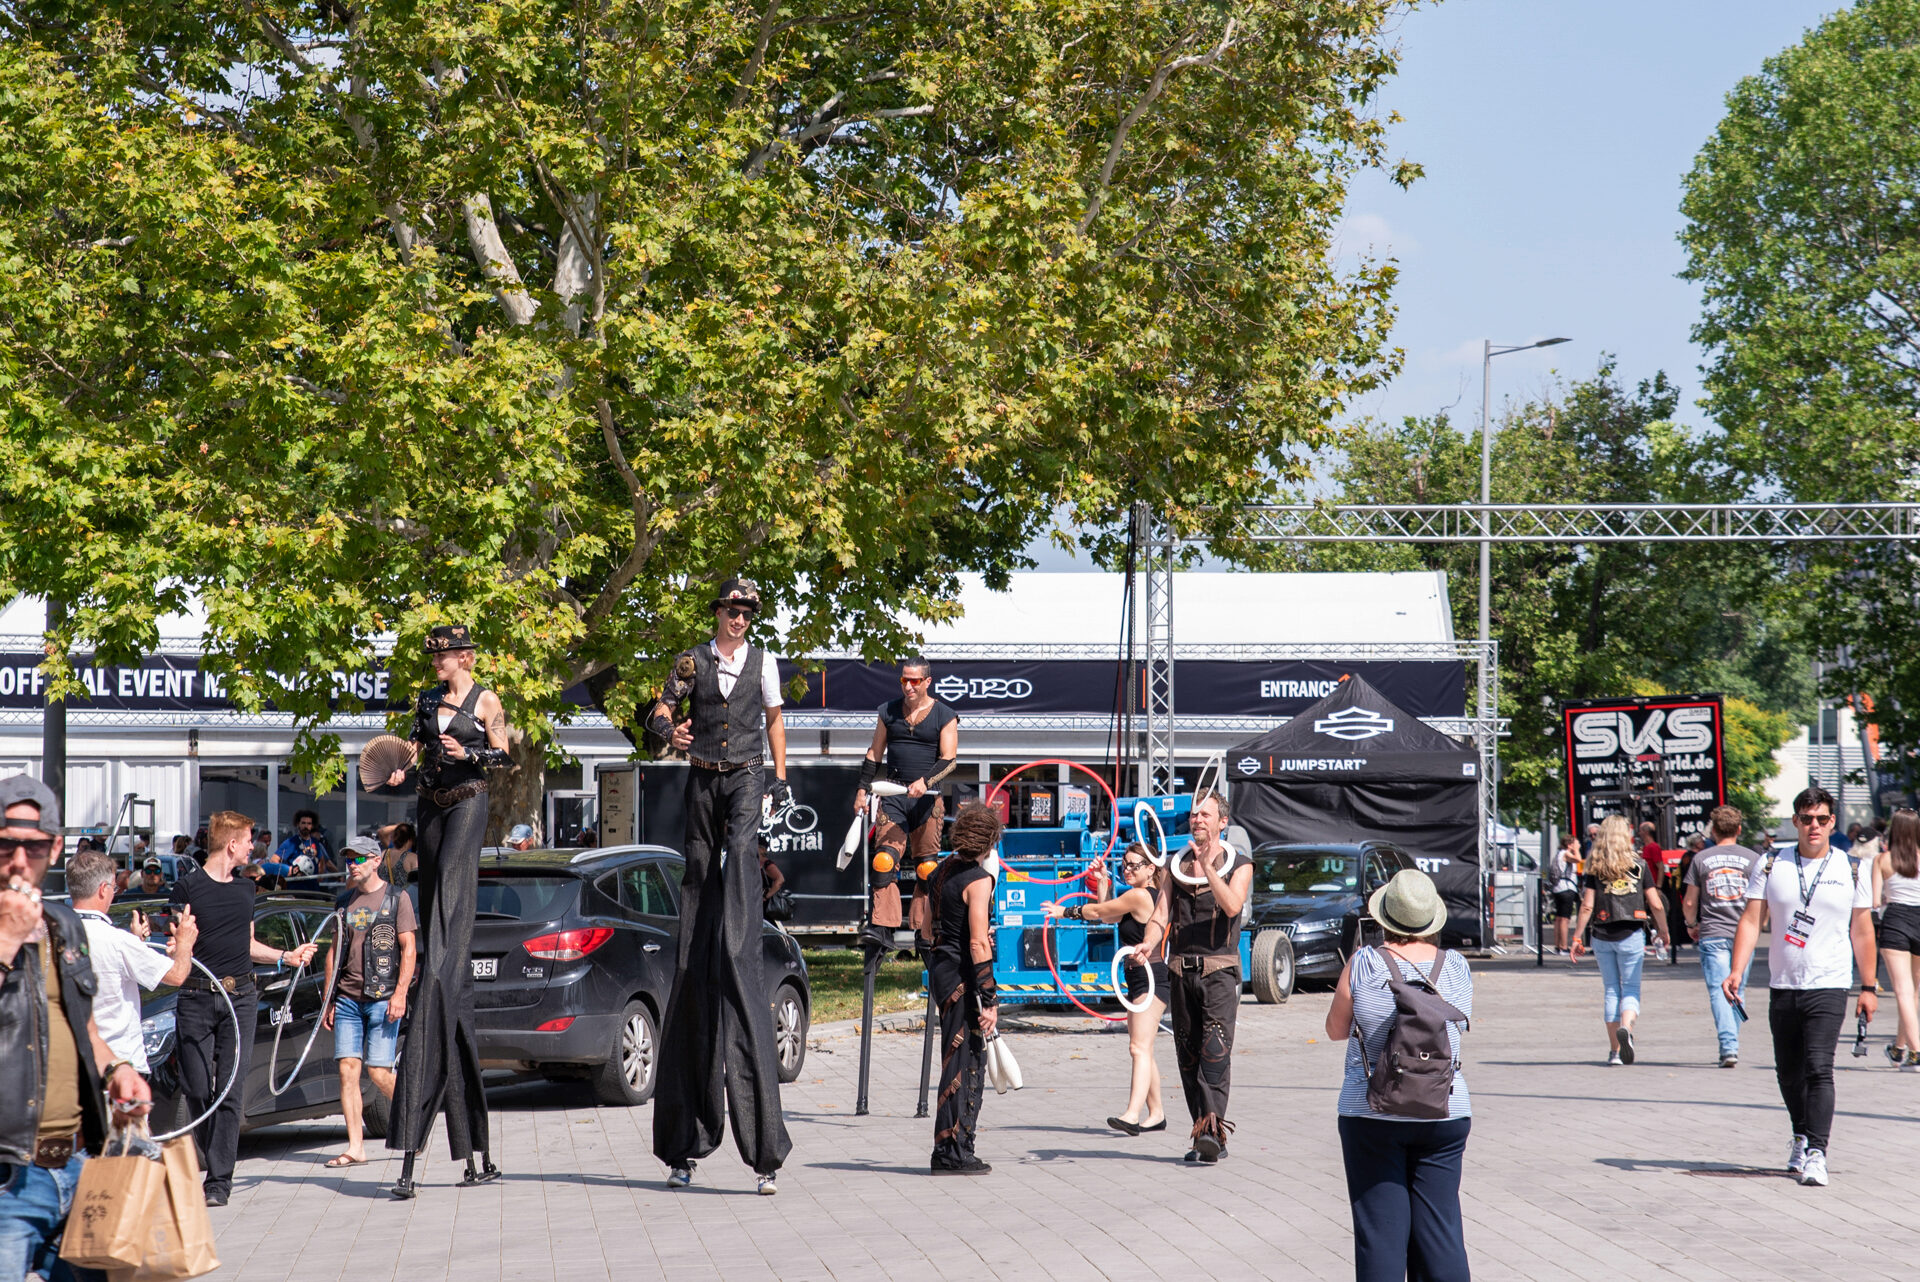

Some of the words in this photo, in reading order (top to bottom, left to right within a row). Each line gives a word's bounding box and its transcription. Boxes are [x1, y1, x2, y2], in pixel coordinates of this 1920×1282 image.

[0, 667, 110, 696] OFFAL
[118, 668, 197, 698] EVENT
[1260, 680, 1339, 698] ENTRANCE
